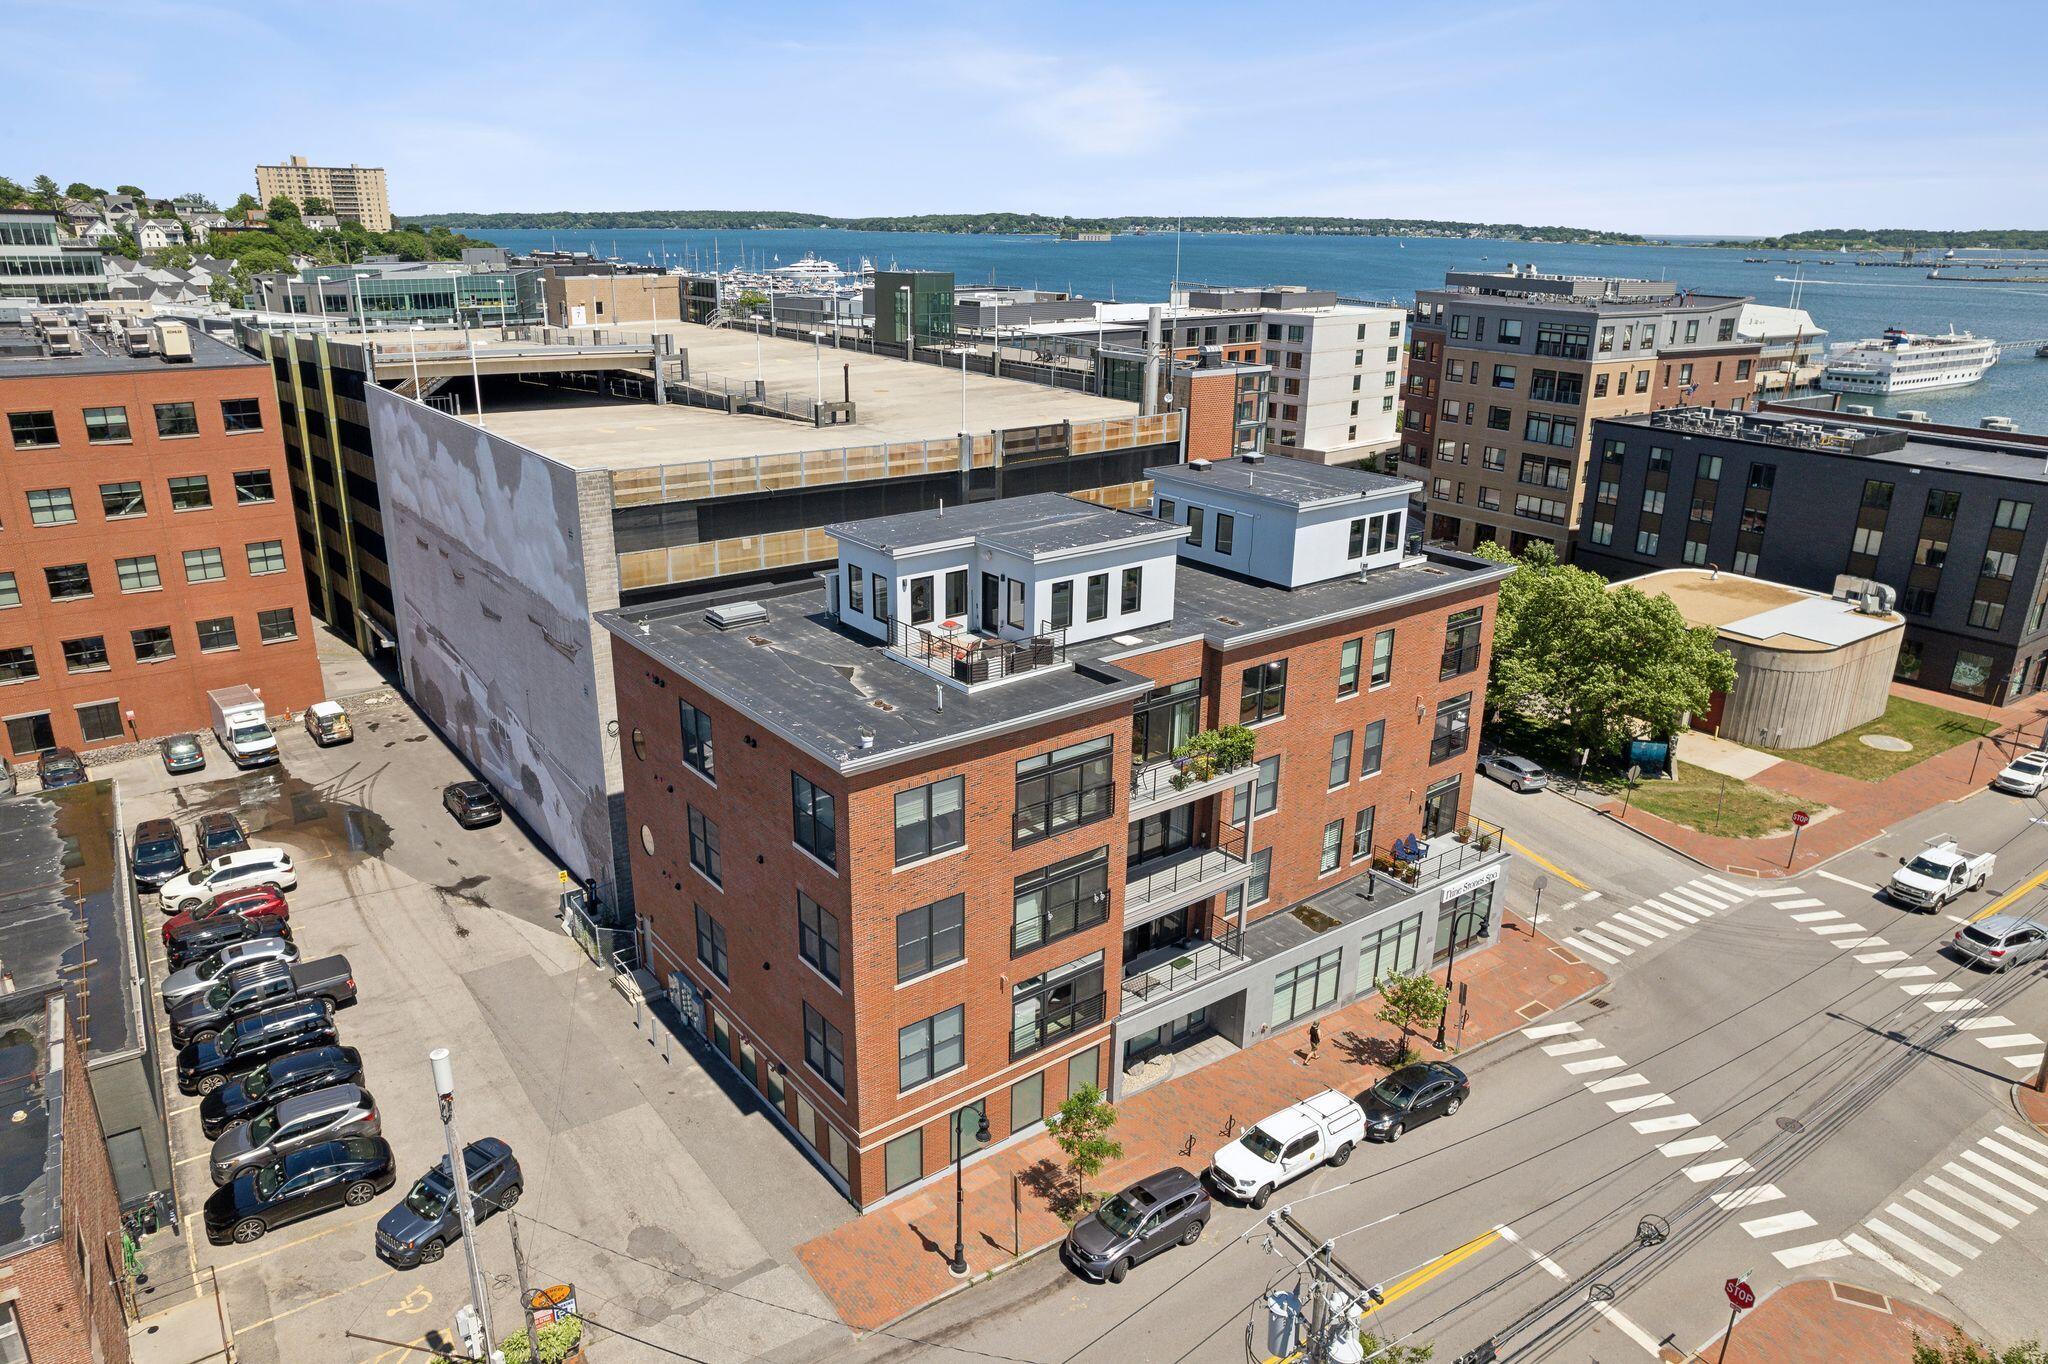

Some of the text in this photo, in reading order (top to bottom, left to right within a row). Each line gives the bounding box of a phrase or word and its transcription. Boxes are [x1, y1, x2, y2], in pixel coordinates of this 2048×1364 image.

[1793, 813, 1809, 823] STOP
[1462, 876, 1485, 893] Stones
[1485, 871, 1498, 883] Spa
[1726, 1282, 1754, 1303] STOP
